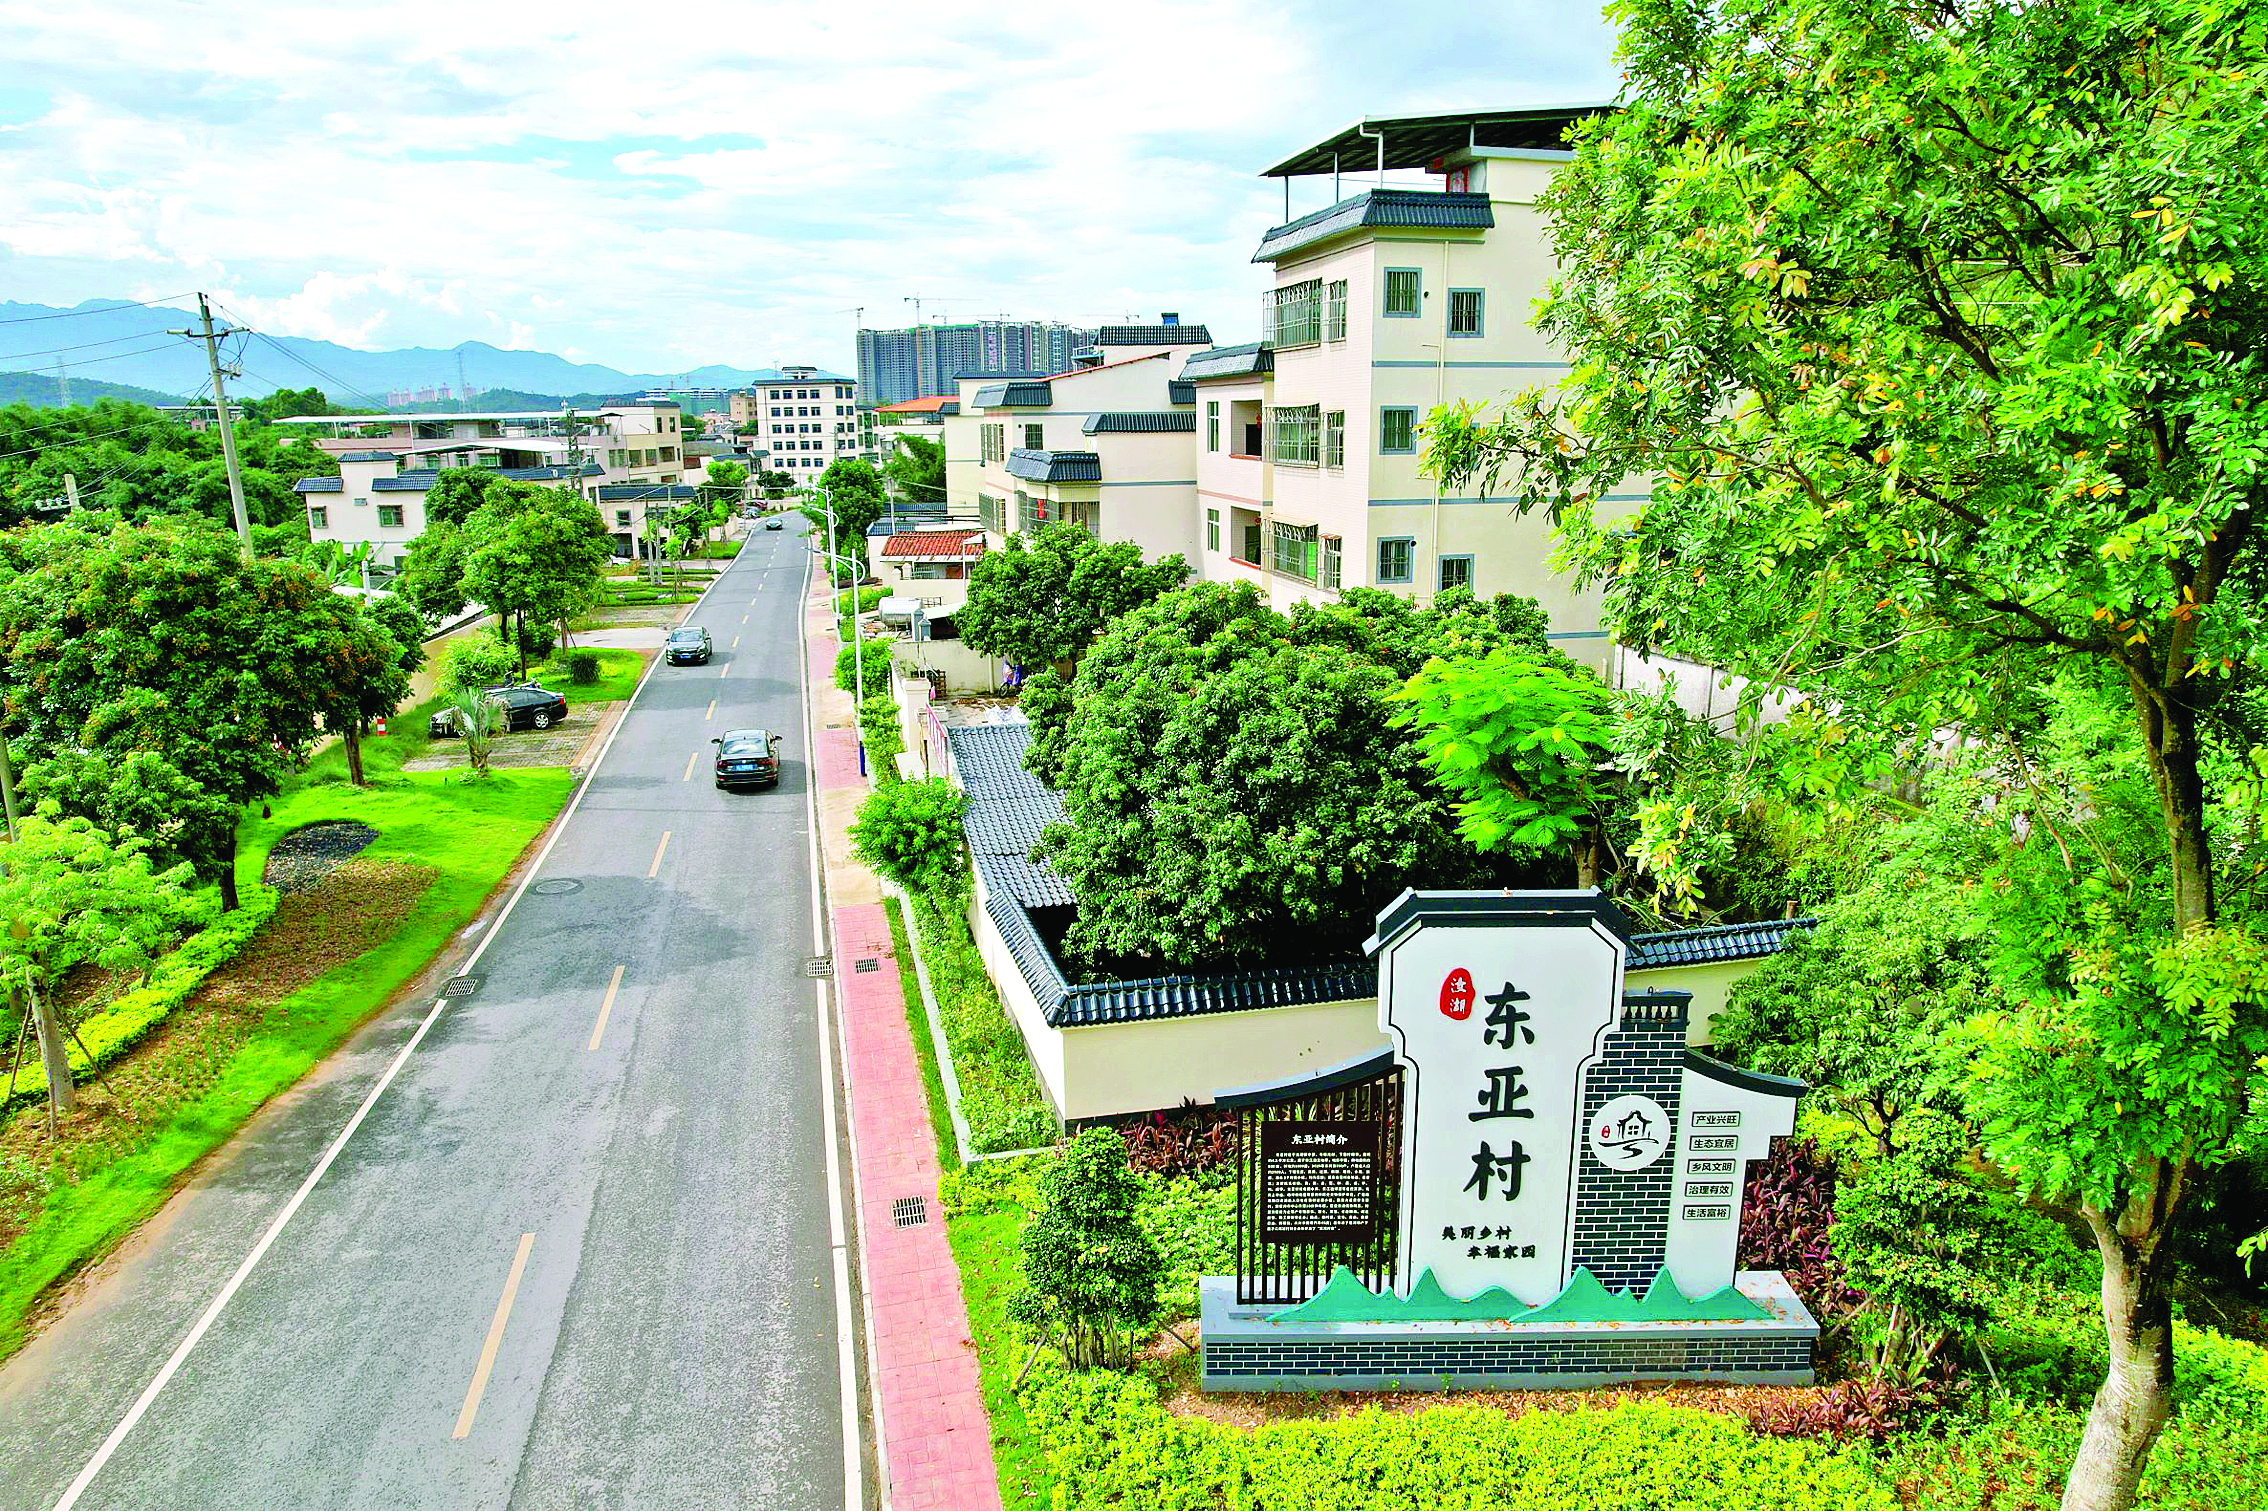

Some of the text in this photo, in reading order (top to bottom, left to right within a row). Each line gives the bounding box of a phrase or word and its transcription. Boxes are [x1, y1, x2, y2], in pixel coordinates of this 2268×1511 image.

[1462, 981, 1536, 1202] 东亚村
[1695, 1115, 1737, 1125] 产业兴旺
[1291, 1133, 1349, 1146] 东亚村简介
[1693, 1138, 1735, 1149] 生态宜居
[1691, 1162, 1733, 1172] 乡风文明
[1688, 1185, 1730, 1195] 治理有效
[1686, 1208, 1727, 1218] 生活富裕
[1441, 1225, 1513, 1241] 美丽乡村
[1466, 1244, 1537, 1260] 幸福家园
